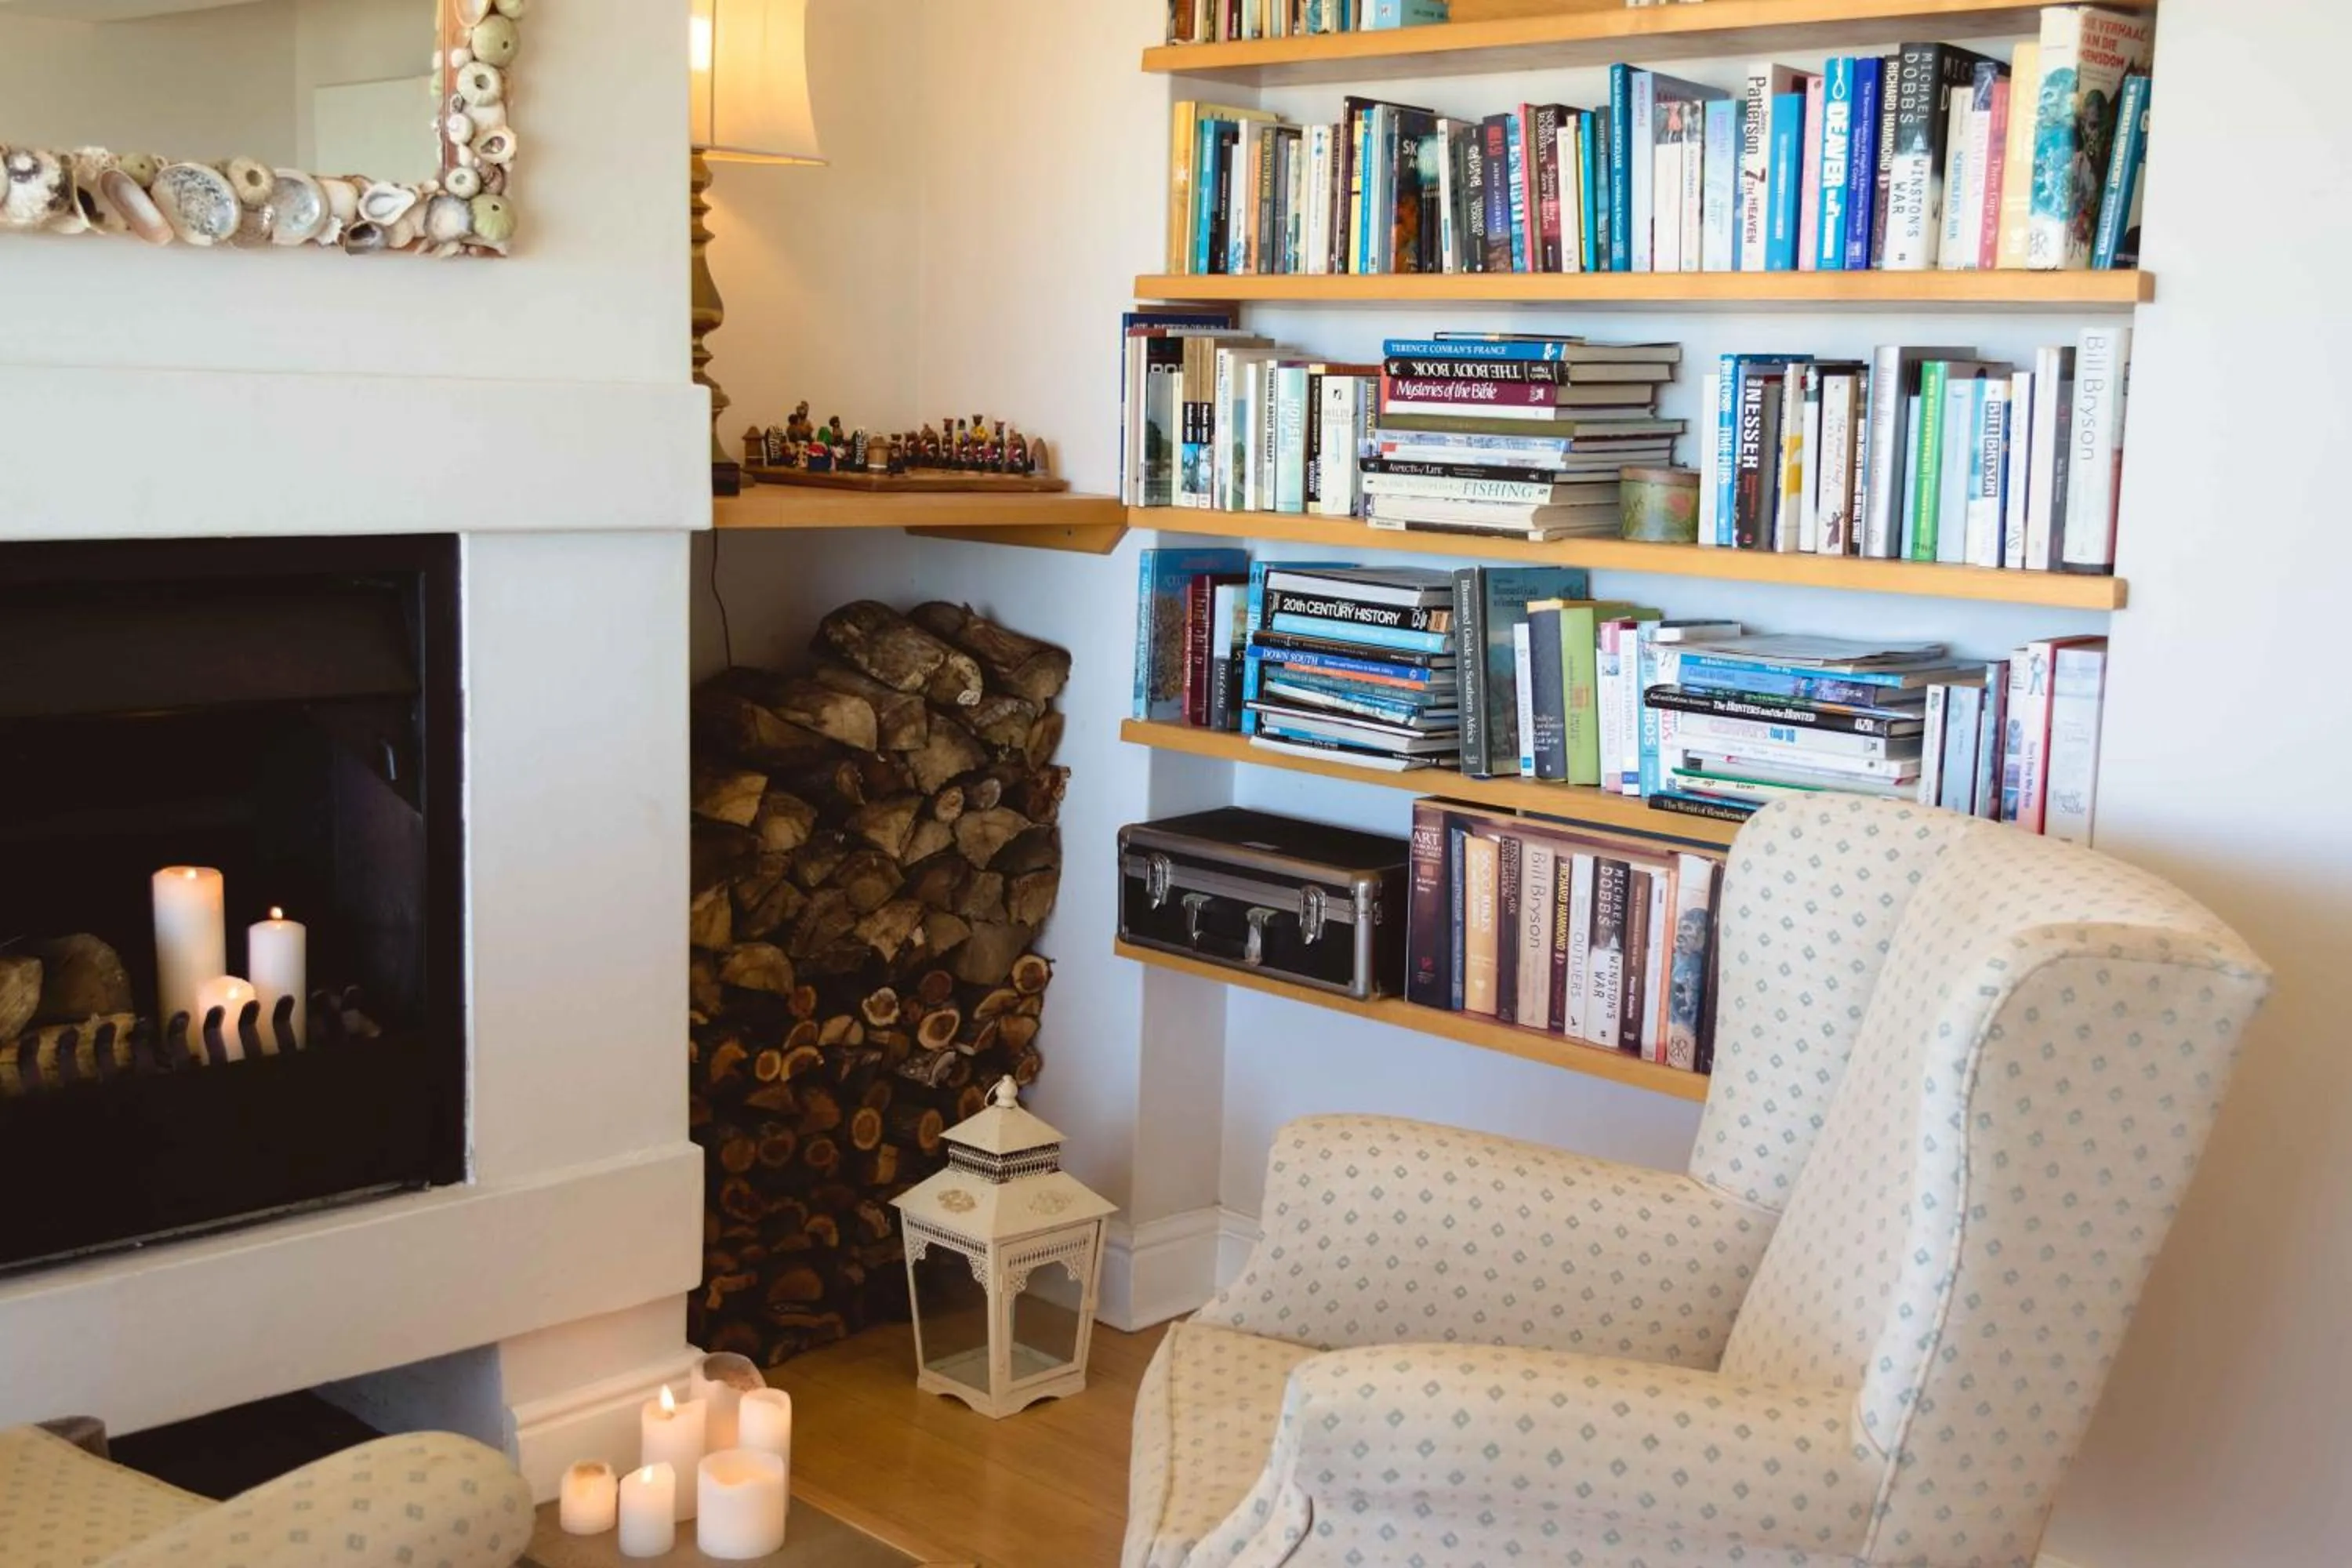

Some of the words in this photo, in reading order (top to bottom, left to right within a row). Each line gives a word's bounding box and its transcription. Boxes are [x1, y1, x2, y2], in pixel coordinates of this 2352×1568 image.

[1884, 62, 1899, 110] RICHARD
[1900, 52, 1918, 124] DOBBS
[1917, 53, 1933, 123] MICHAEL
[1546, 111, 1556, 144] NORA
[1745, 76, 1766, 154] Patterson
[1537, 112, 1548, 163] ROBERTS
[1823, 101, 1849, 188] DEAVER
[1880, 114, 1895, 170] HAMMOND
[1892, 181, 1906, 215] WAR
[1907, 159, 1926, 238] WINSTON'S
[1746, 197, 1759, 244] HEAVEN
[1391, 344, 1426, 353] TERENCE
[1473, 346, 1506, 355] FRANCE
[1411, 361, 1450, 377] BOOK
[2085, 336, 2107, 372] Bill
[1267, 367, 1276, 403] THINKING
[1396, 379, 1443, 400] Mysteries
[1456, 382, 1471, 398] the
[1471, 382, 1497, 401] Bible
[1453, 363, 1489, 379] BODY
[1491, 364, 1520, 379] THE
[1742, 388, 1762, 469] NESSER
[1984, 401, 2001, 434] BILL
[2079, 379, 2103, 461] Bryson
[1983, 438, 1999, 497] BRYSON
[1463, 481, 1533, 499] FISHING
[1283, 598, 1305, 612] 20th
[1306, 601, 1354, 619] CENTURY
[1355, 607, 1401, 626] HISTORY
[1263, 648, 1289, 661] DOWN
[1290, 650, 1319, 666] SOUTH
[1463, 627, 1475, 657] Guide
[1464, 671, 1475, 713] Southern
[1712, 700, 1726, 709] The
[1465, 716, 1476, 745] Africa
[1413, 831, 1440, 846] ART
[1530, 851, 1548, 879] Bill
[1556, 862, 1569, 901] RICHARD
[1597, 865, 1613, 926] DOBBS
[1610, 868, 1625, 926] MICHAEL
[1527, 884, 1548, 949] Bryson
[1555, 904, 1566, 950] HAMMOND
[1570, 931, 1585, 999] OUTLIERS
[1592, 971, 1606, 999] WAR
[1606, 955, 1620, 1020] WINSTON'S
